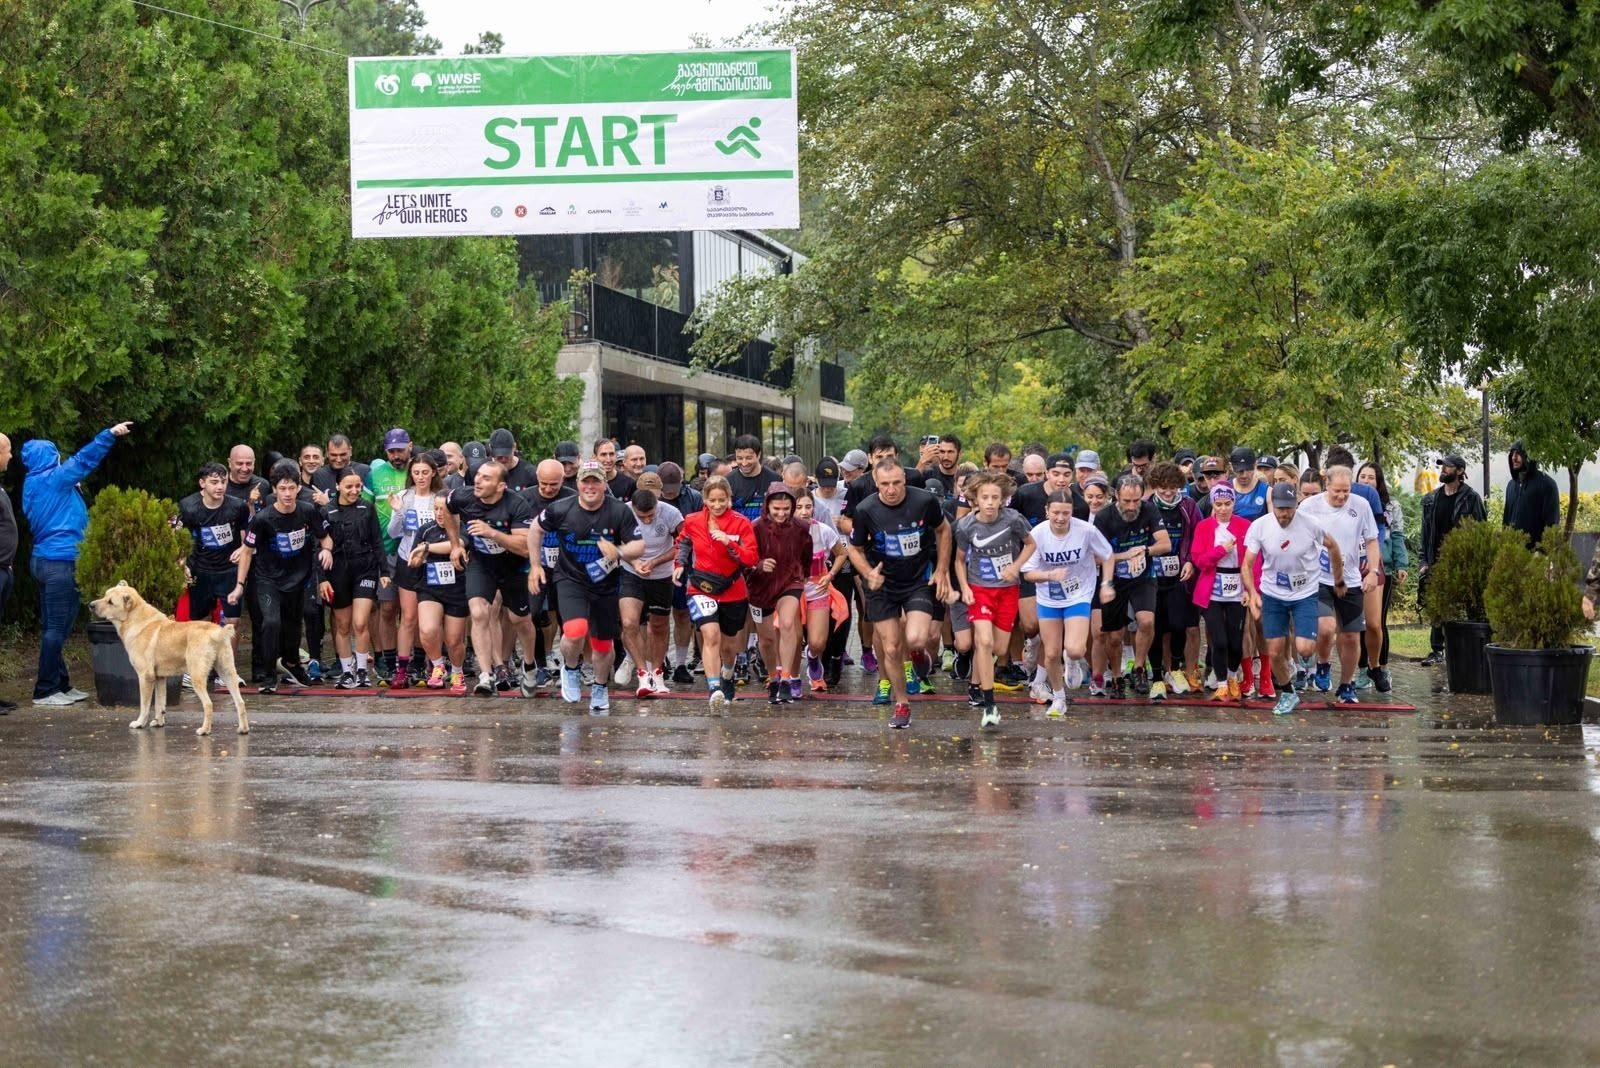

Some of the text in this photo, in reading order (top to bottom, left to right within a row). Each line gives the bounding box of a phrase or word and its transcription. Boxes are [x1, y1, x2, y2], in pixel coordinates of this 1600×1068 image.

[437, 73, 481, 84] WWSF
[483, 115, 678, 170] START
[387, 194, 452, 208] LET'S UNITE
[400, 210, 422, 224] OUR
[425, 209, 468, 223] HEROES
[217, 531, 231, 540] 204
[903, 540, 919, 550] 102
[1045, 548, 1081, 562] NAVY
[360, 579, 376, 589] ARMY
[1065, 583, 1079, 593] 122
[701, 601, 716, 609] 173
